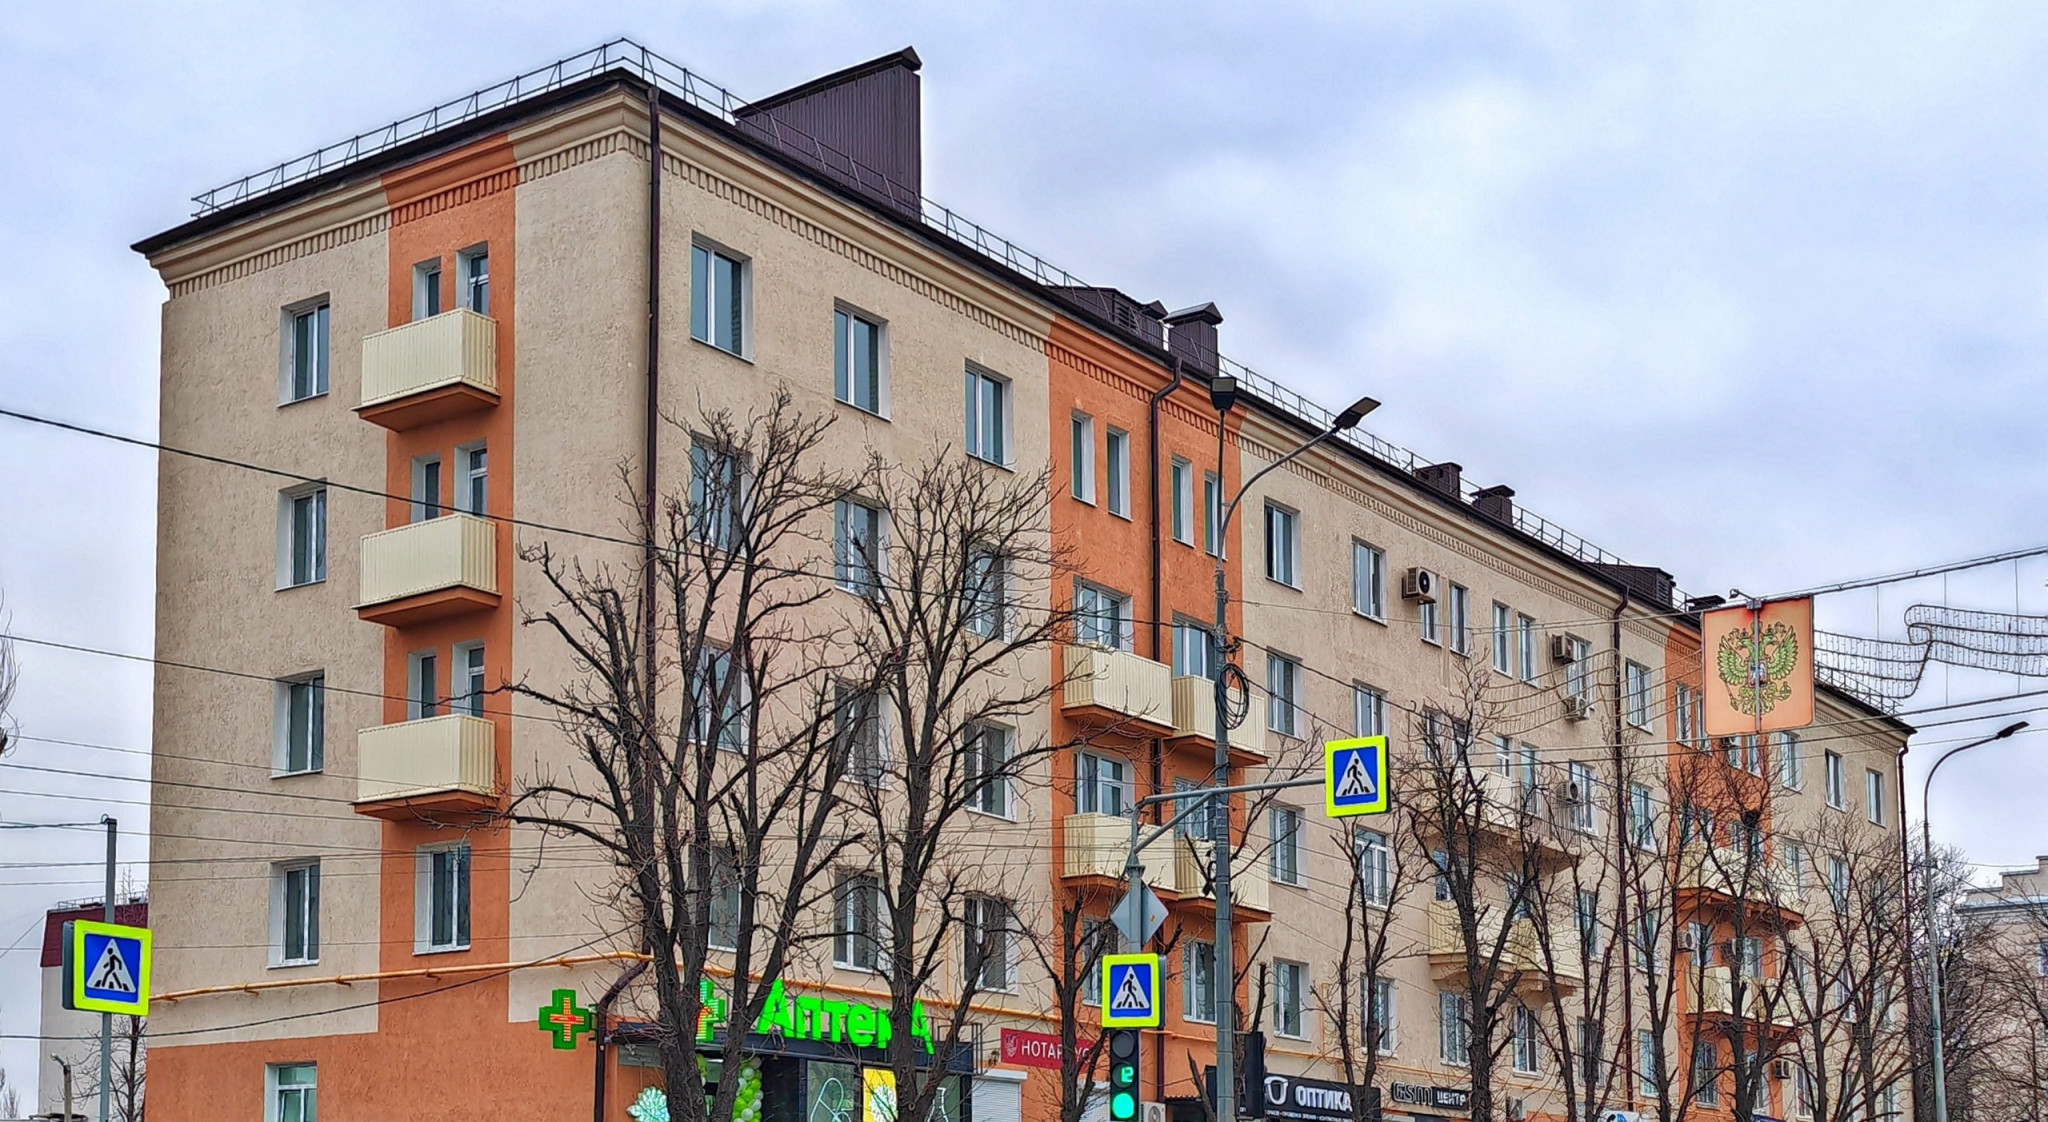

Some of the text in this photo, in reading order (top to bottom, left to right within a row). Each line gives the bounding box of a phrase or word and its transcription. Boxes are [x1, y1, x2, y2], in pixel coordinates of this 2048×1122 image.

[1021, 1040, 1091, 1064] НОТАРУС
[1295, 1085, 1353, 1112] ОПТИКА
[1436, 1090, 1466, 1106] ЦЕНТР
